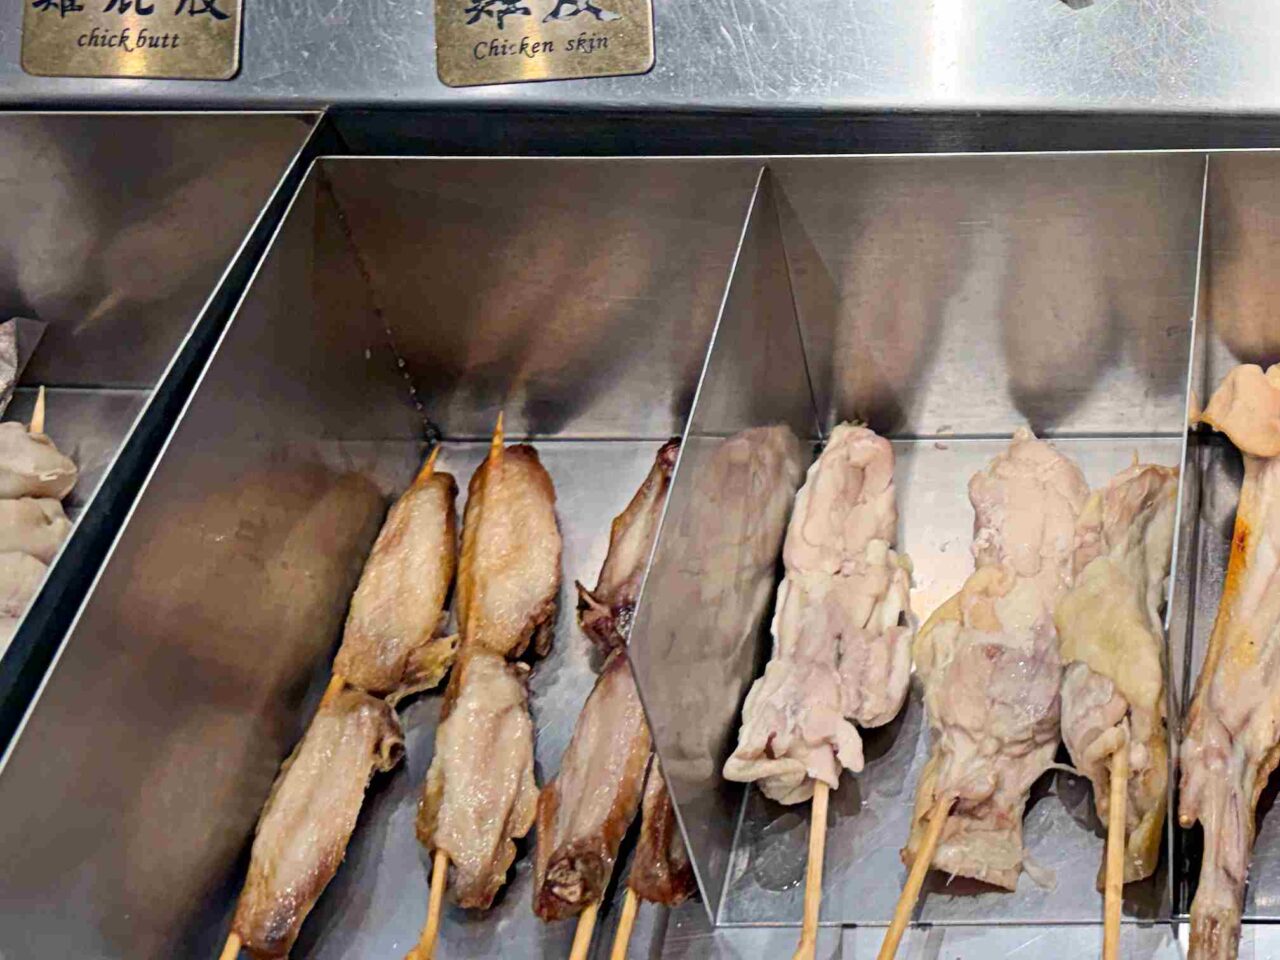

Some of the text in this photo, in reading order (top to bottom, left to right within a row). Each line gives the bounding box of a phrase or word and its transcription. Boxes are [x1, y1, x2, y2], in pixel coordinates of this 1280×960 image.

[77, 27, 181, 52] chick butt
[473, 31, 609, 60] Chicken skin
